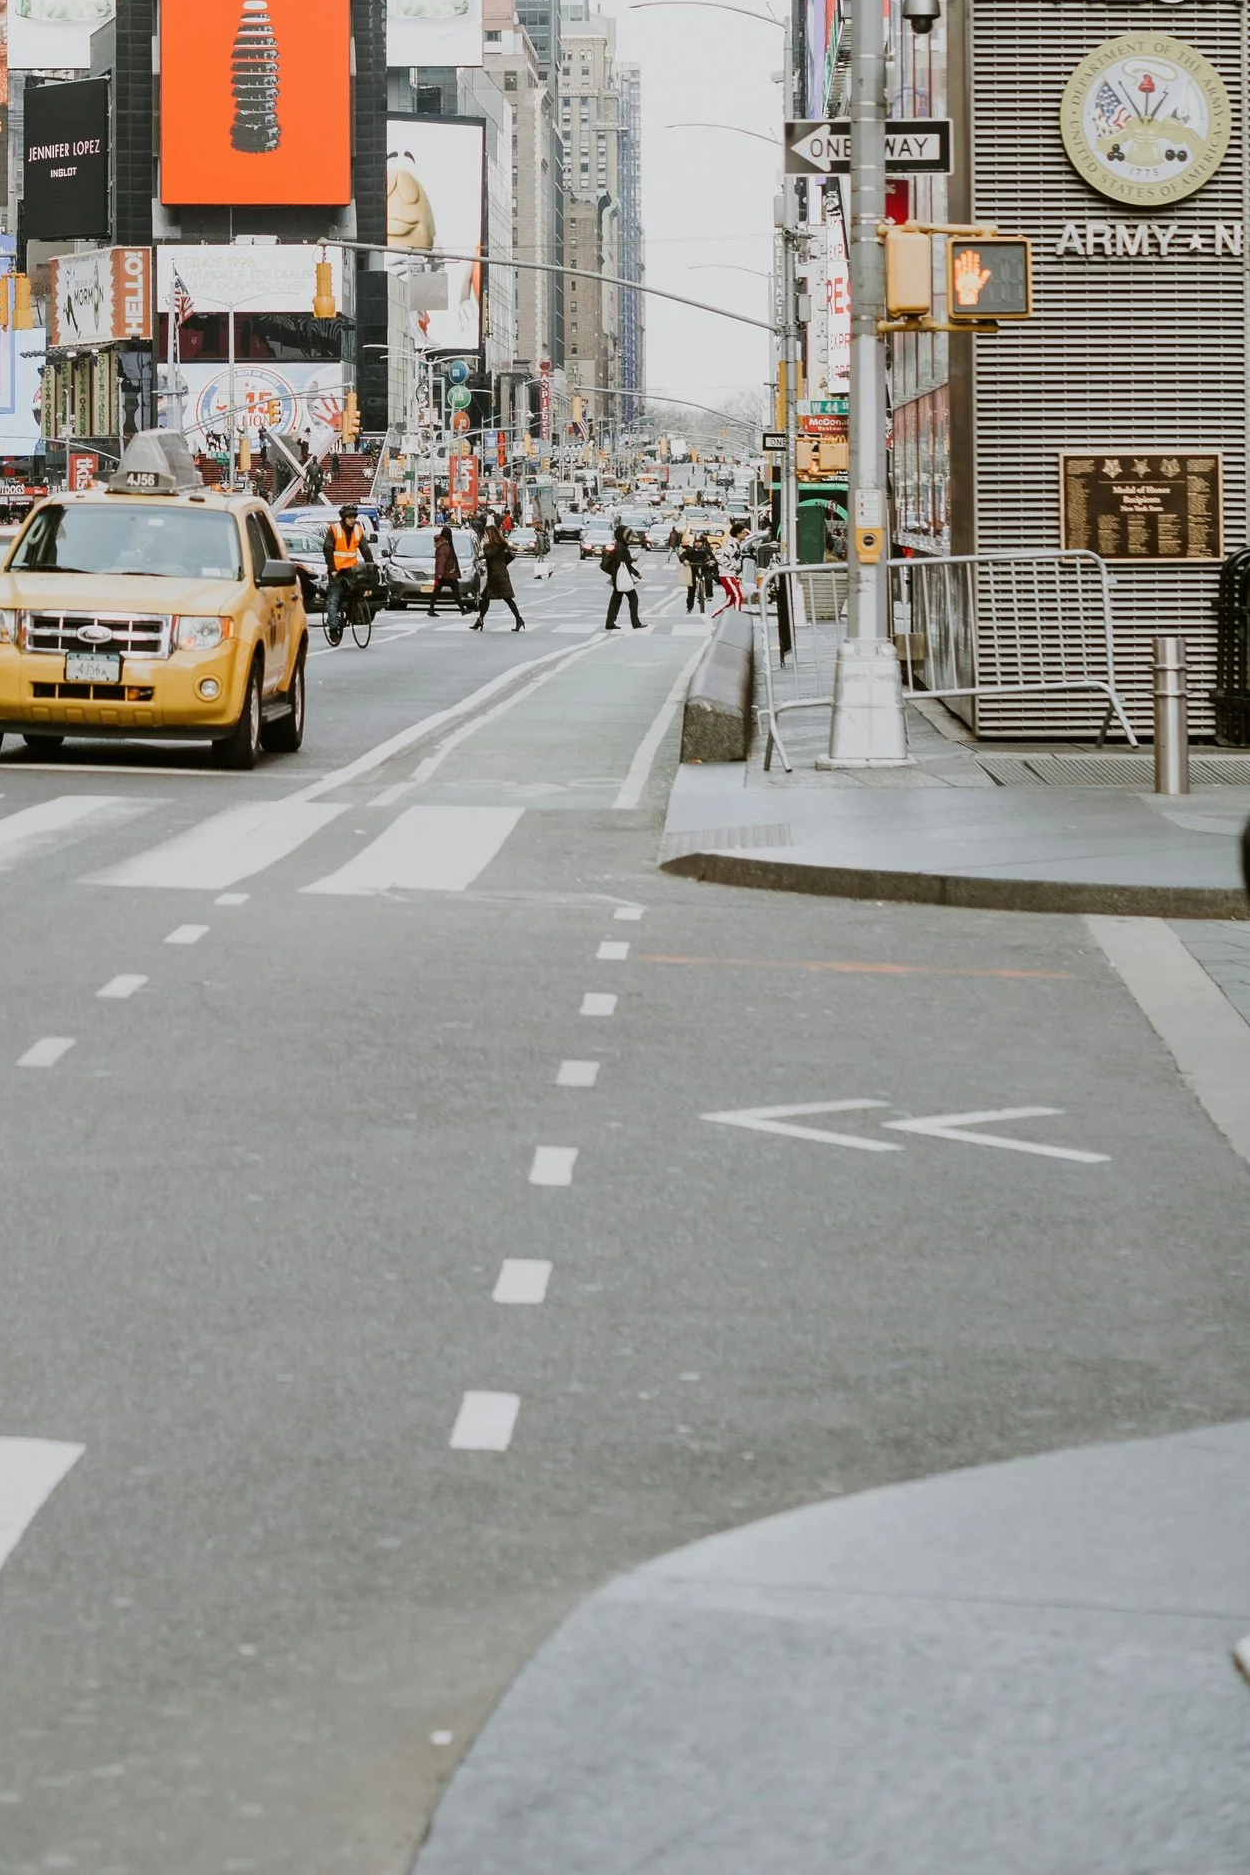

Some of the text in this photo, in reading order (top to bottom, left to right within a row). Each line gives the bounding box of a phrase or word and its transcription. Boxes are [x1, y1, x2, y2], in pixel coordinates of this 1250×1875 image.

[1071, 40, 1224, 120] DEPARTMENT OF THE ARMY
[28, 139, 101, 163] JENNIFER LOPEZ
[810, 136, 852, 159] ONE
[1071, 118, 1224, 200] UNITED STATES OF AMERICA
[50, 166, 78, 178] INGLOT
[1129, 166, 1161, 178] 1775
[1055, 223, 1179, 256] ARMY
[184, 256, 223, 268] SINCE
[74, 286, 104, 307] MORMN
[124, 251, 144, 334] HELLO!
[811, 402, 822, 414] W
[825, 402, 839, 414] 44
[808, 418, 850, 426] McDonal
[126, 472, 156, 487] 4J56
